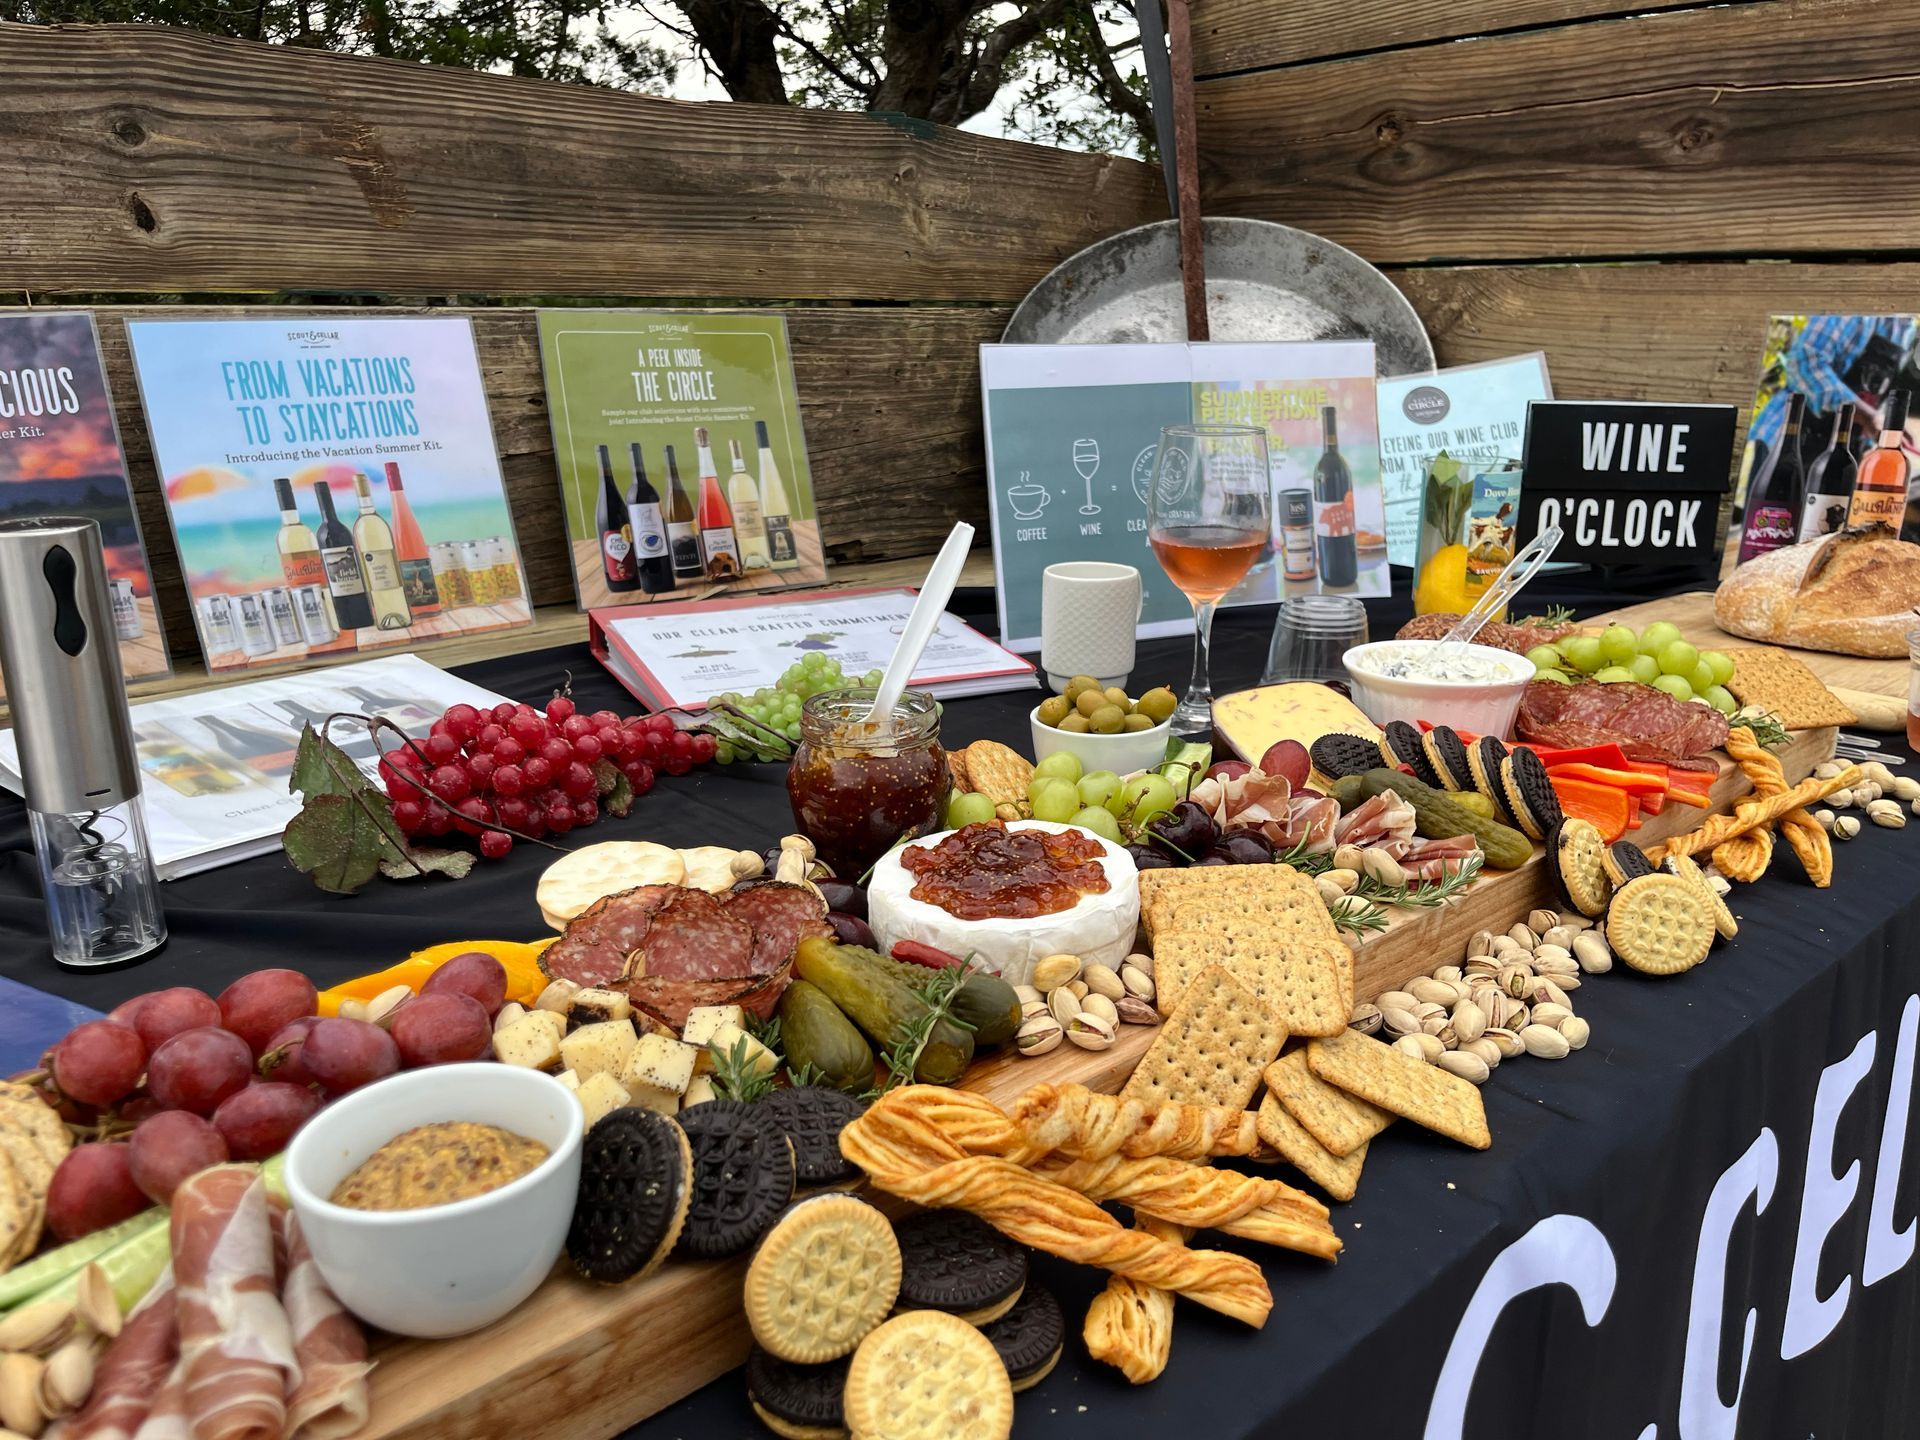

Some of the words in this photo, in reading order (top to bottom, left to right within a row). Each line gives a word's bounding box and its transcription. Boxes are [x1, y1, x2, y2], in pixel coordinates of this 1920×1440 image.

[638, 349, 646, 368] A
[648, 349, 671, 368] PEEK
[674, 349, 704, 367] INSIDE
[0, 367, 80, 418] CIOUS
[221, 360, 291, 401] FROM
[297, 356, 416, 398] VACATIONS
[631, 371, 662, 402] THE
[667, 371, 717, 401] CIRCLE
[18, 426, 45, 438] Kit.
[236, 405, 271, 446] TO
[278, 399, 420, 444] STAYCATIONS
[1383, 435, 1423, 455] EYEING
[1427, 431, 1450, 450] OUR
[1454, 426, 1486, 446] WINE
[1490, 421, 1519, 441] CLUB
[226, 450, 300, 464] Introducing
[301, 448, 320, 460] the
[323, 445, 374, 458] Vacation
[375, 443, 421, 455] Summer
[423, 441, 443, 451] Kit.
[1582, 422, 1690, 473] WINE
[1017, 527, 1047, 542] COFFEE
[1080, 523, 1102, 536] WINE
[1127, 519, 1148, 532] CLEA
[1536, 498, 1702, 548] O'CLOCK
[652, 631, 683, 641] OUR
[690, 621, 813, 638] CLEAN-CRAFTED
